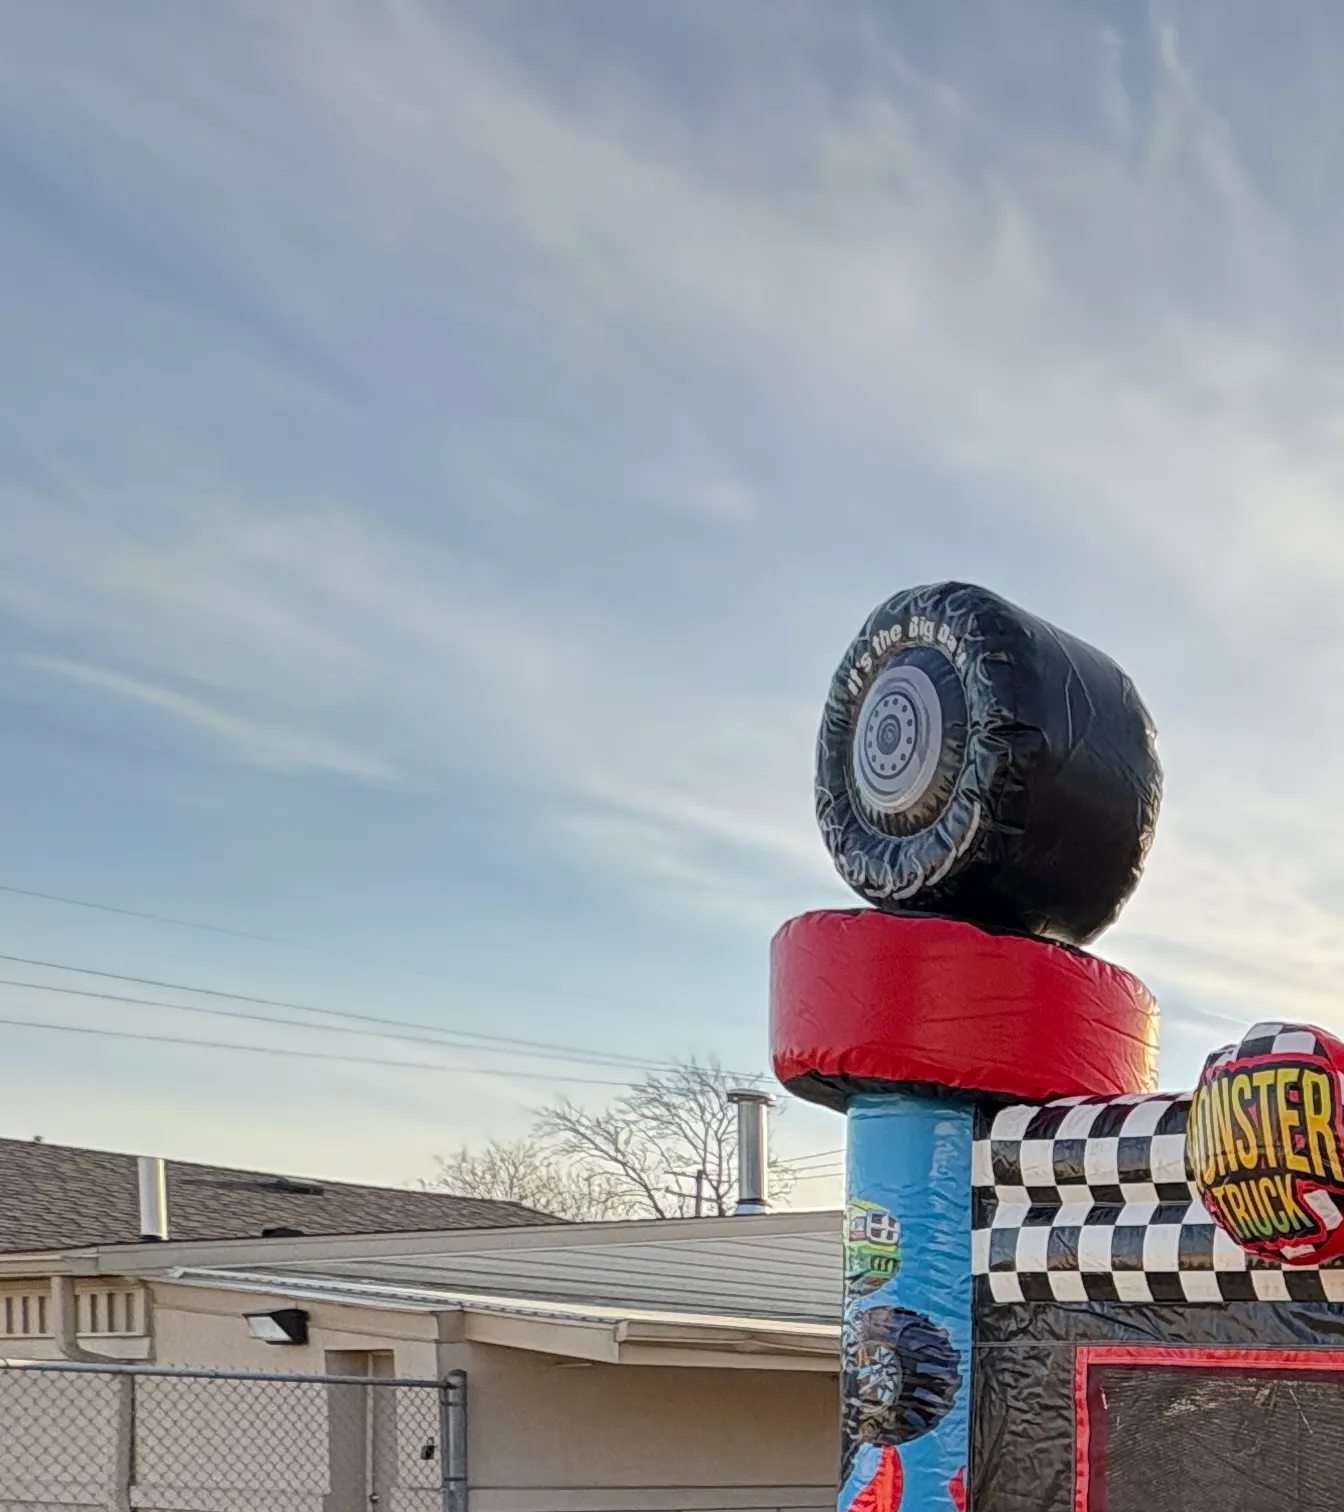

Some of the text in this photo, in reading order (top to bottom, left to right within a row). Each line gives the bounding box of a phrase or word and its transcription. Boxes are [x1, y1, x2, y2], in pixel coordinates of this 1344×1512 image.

[872, 624, 903, 657] the
[909, 616, 935, 643] Big
[1212, 1173, 1315, 1239] TRUCK
